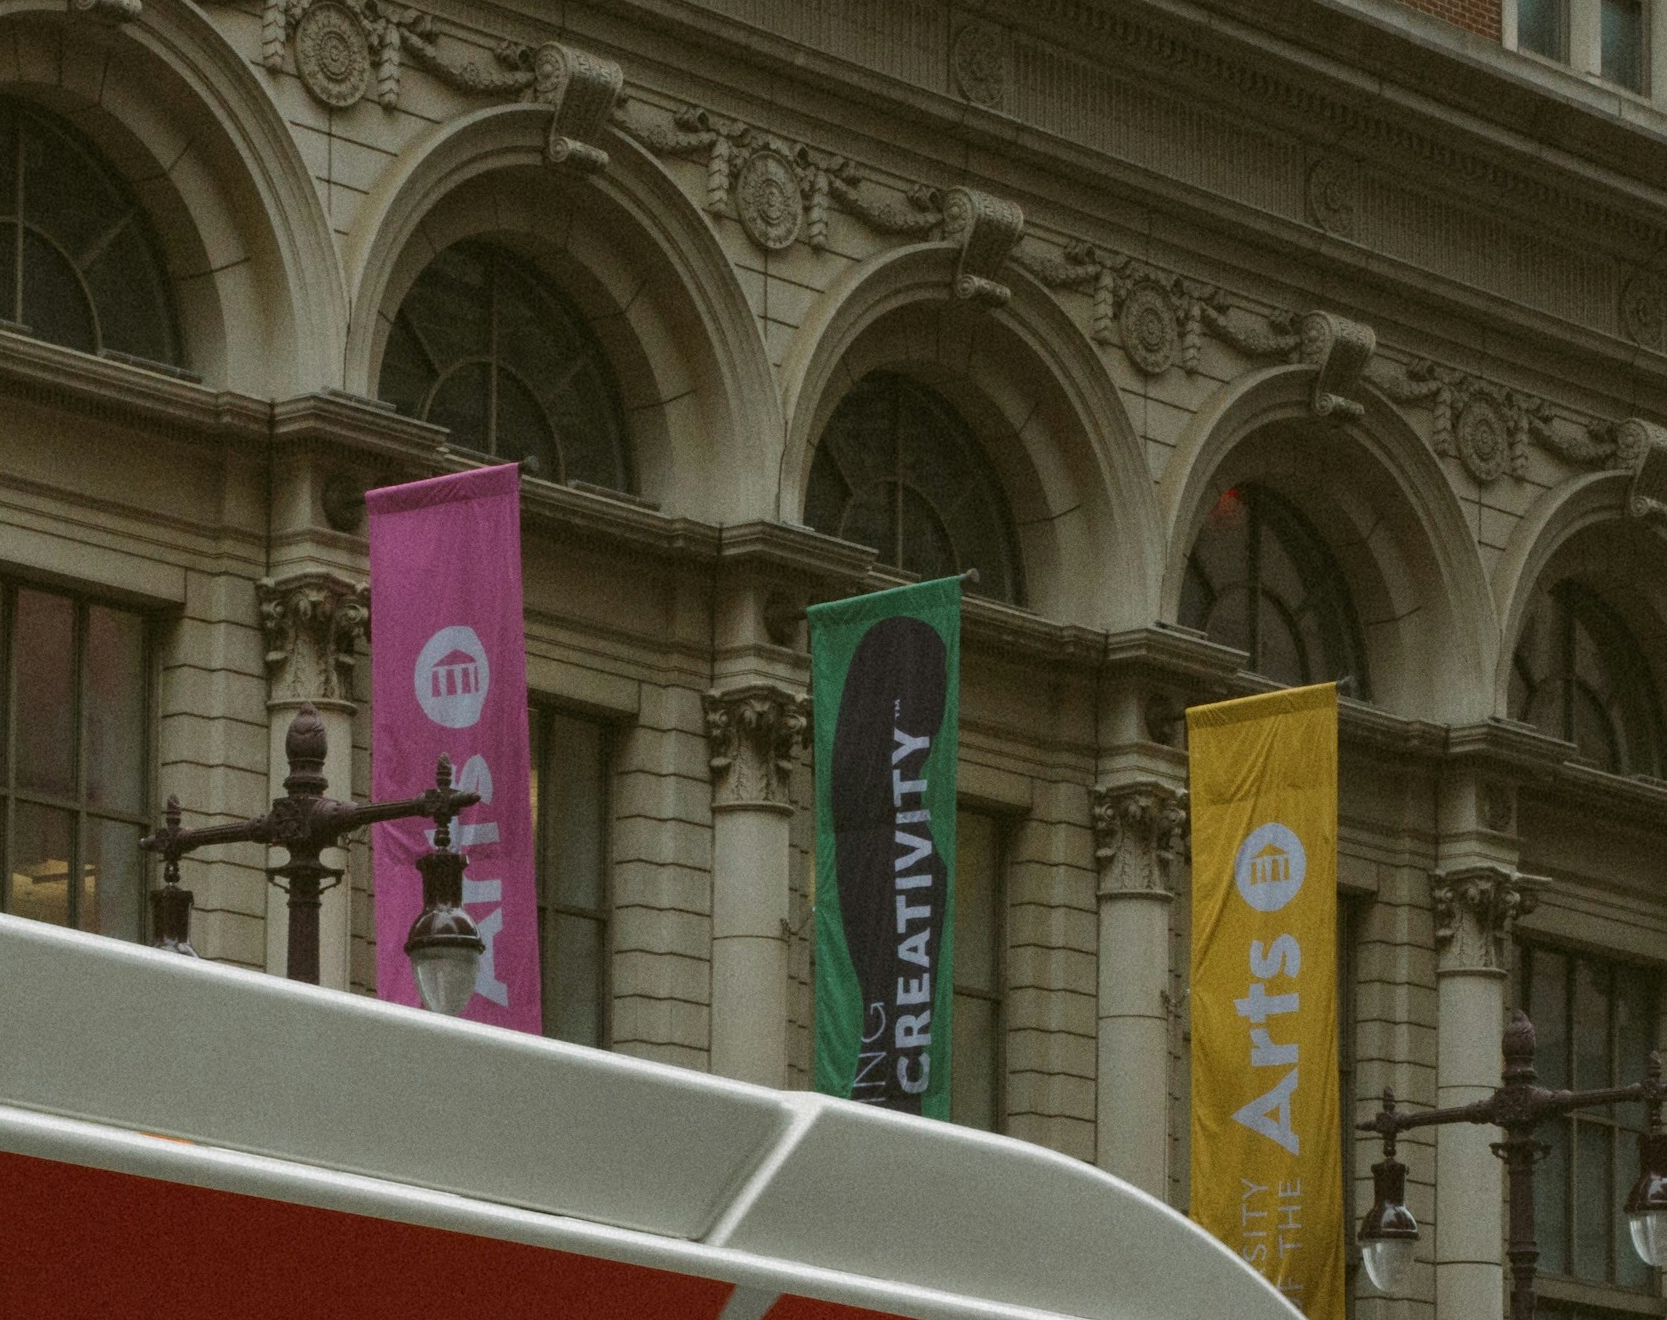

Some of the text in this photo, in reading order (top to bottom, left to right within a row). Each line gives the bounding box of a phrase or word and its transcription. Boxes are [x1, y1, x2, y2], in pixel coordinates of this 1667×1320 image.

[1230, 933, 1302, 1157] Arts
[1240, 1177, 1269, 1277] SITY
[1276, 1177, 1303, 1258] THE
